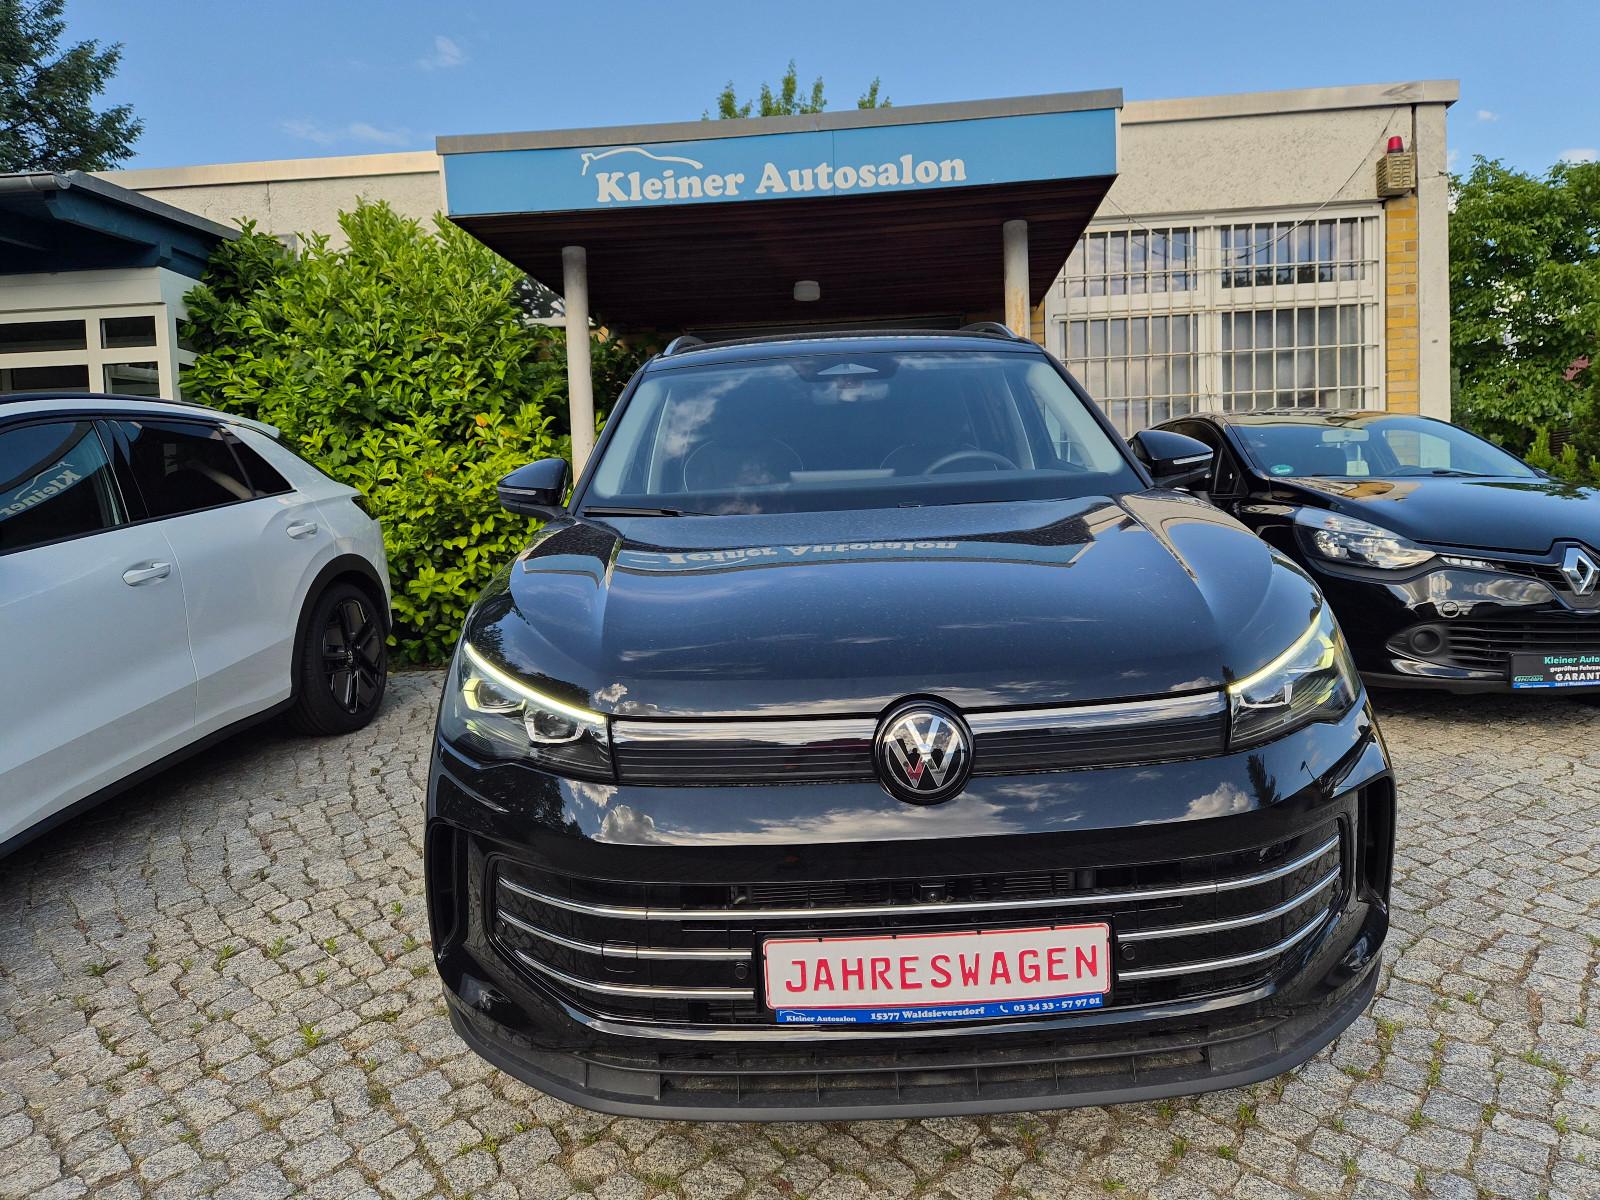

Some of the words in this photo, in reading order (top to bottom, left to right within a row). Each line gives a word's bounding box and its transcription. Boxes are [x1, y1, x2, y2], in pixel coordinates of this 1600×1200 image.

[596, 169, 745, 202] Kleiner
[755, 154, 967, 194] Autosalon
[1544, 656, 1577, 665] Kleiner
[1555, 672, 1600, 681] GARANT
[885, 713, 964, 793] VW
[785, 945, 1098, 993] JAHRESWAGEN
[1013, 1004, 1026, 1012] 03
[1028, 1003, 1040, 1011] 34
[1042, 1002, 1054, 1010] 33
[1062, 1000, 1074, 1008] 57
[1075, 999, 1088, 1007] 97
[1089, 997, 1101, 1005] 01
[870, 1011, 899, 1020] 15377
[902, 1007, 985, 1017] Waldsieversdorf
